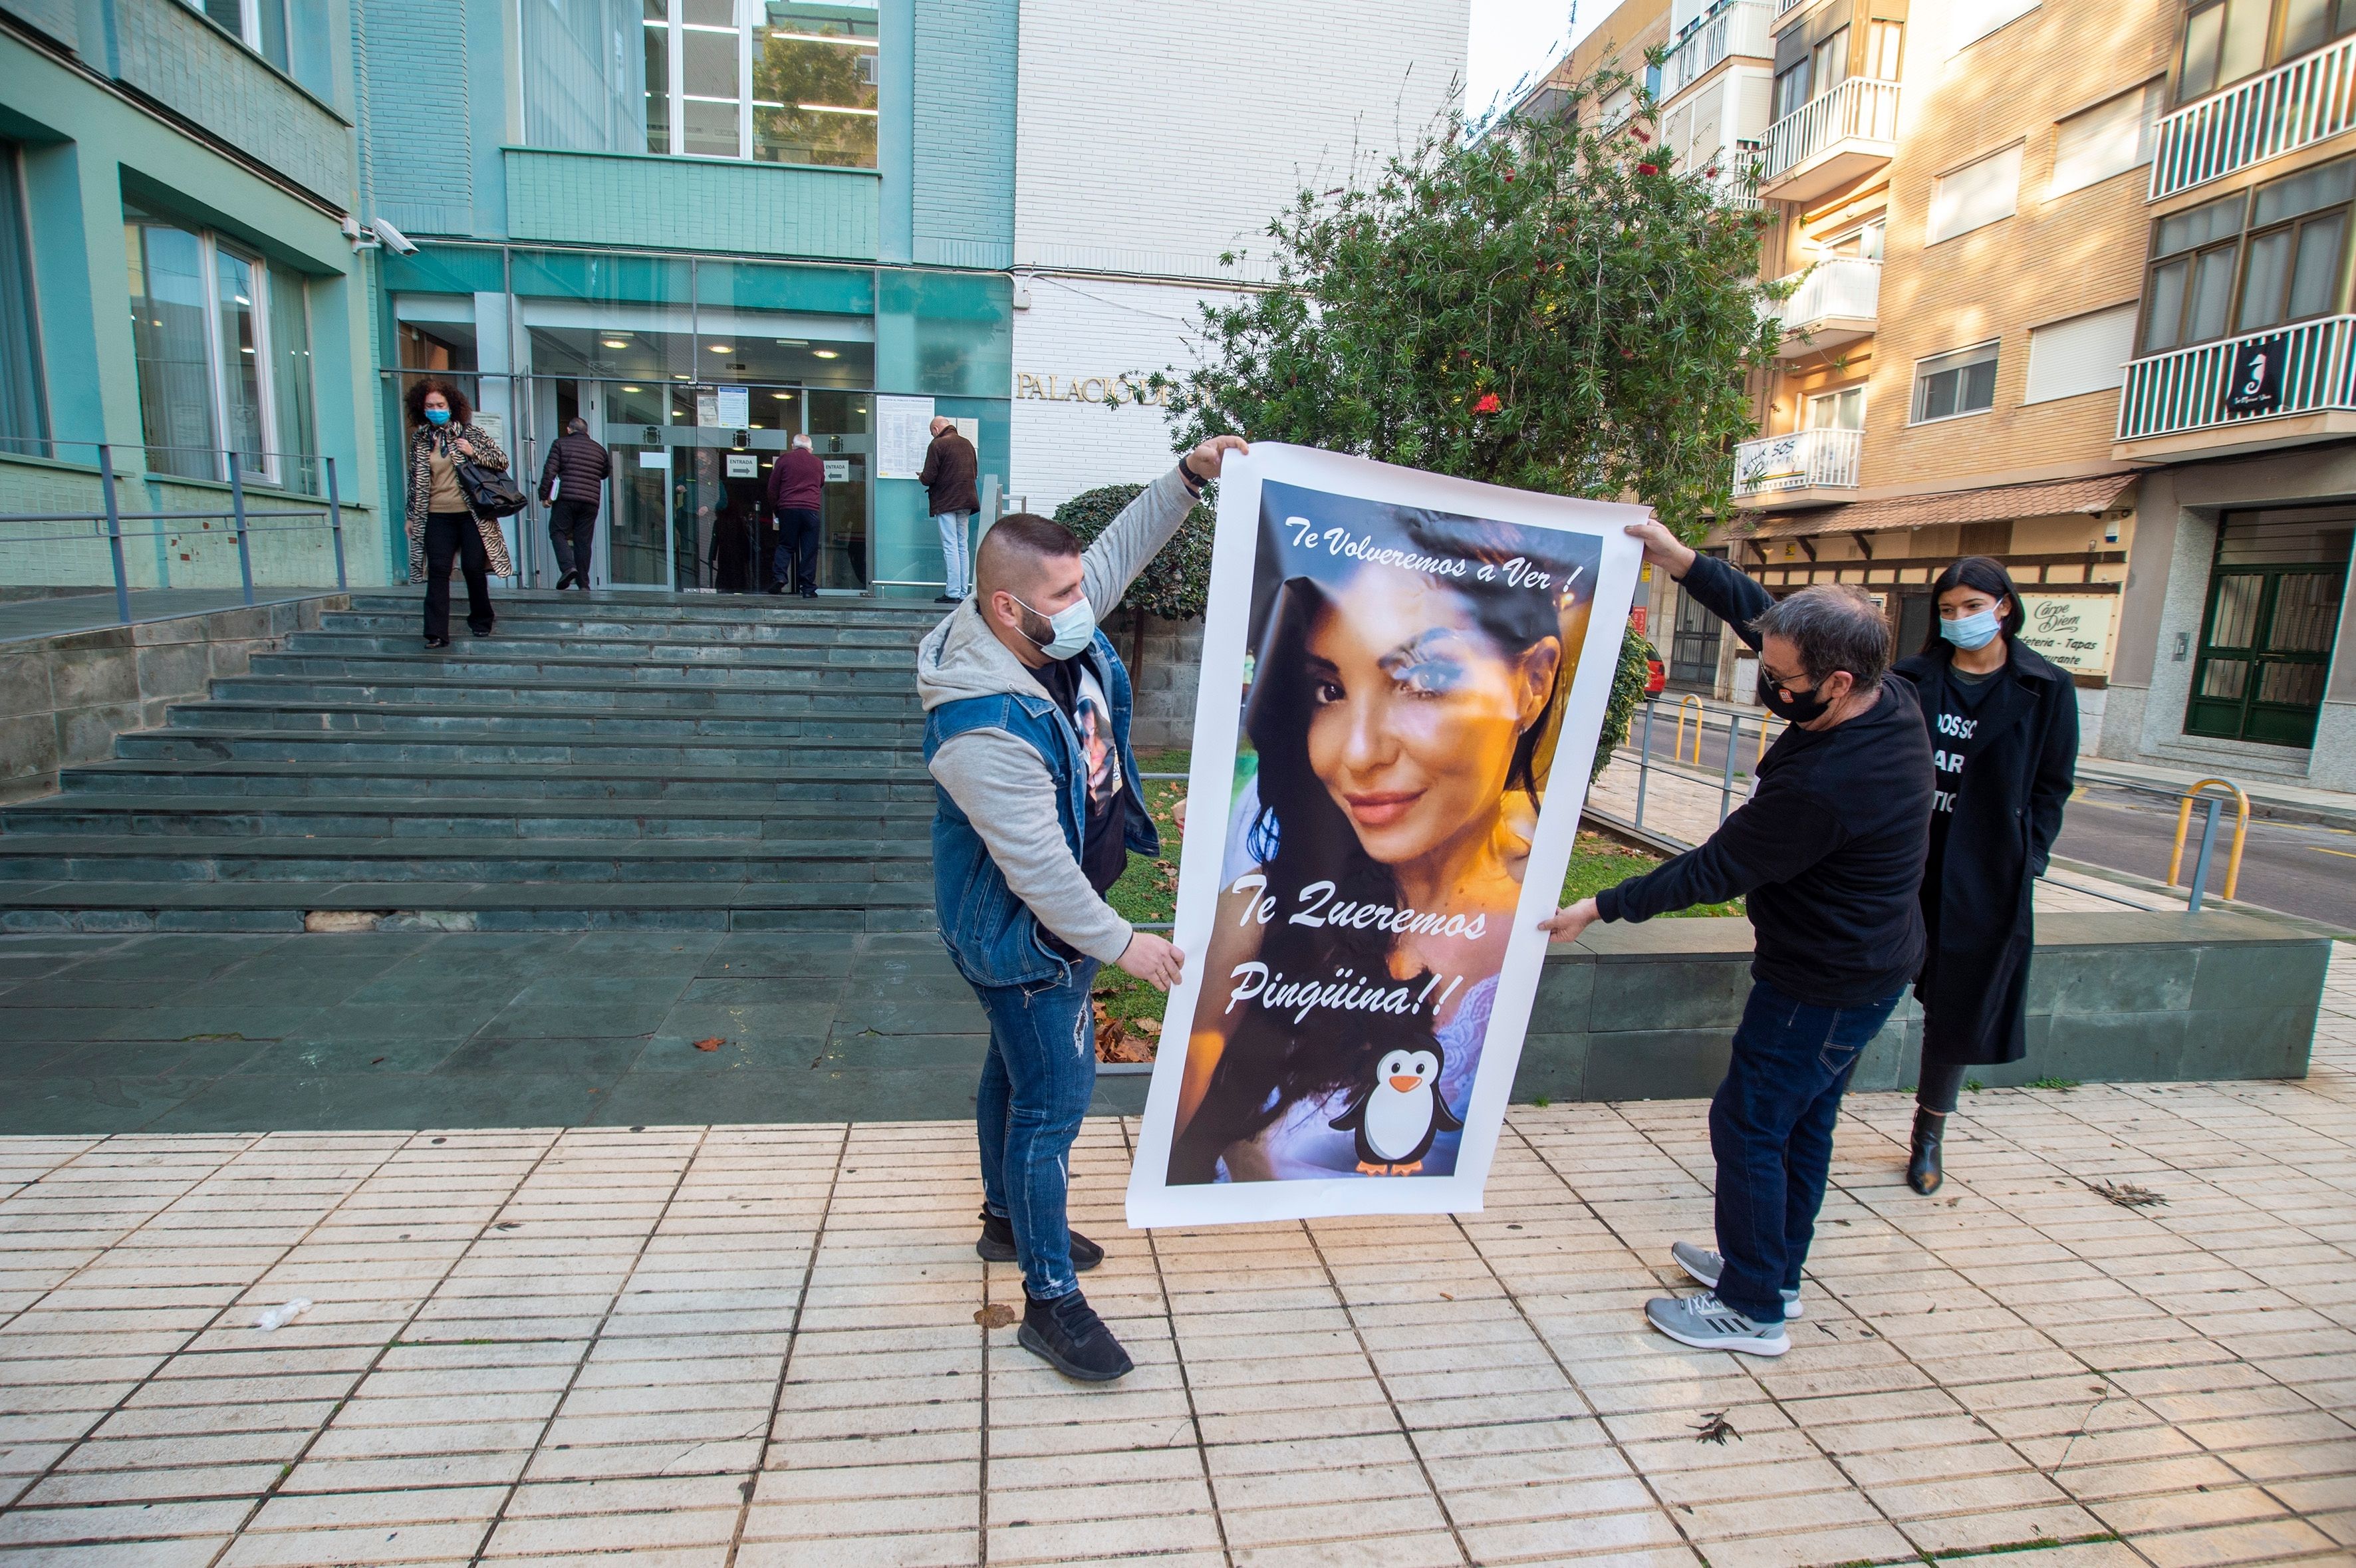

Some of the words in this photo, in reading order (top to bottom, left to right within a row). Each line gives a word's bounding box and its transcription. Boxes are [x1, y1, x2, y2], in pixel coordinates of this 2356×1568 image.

[1016, 373, 1132, 404] PALACIO
[1771, 440, 1795, 457] SOS
[1285, 516, 1319, 548] Te
[1323, 527, 1467, 577] Volveremos
[1477, 562, 1496, 582] a
[1503, 557, 1551, 590] Ver
[2034, 600, 2069, 619] Carpe
[2038, 614, 2081, 633] Diem
[2022, 636, 2055, 647] feteria
[2065, 638, 2098, 651] Tapas
[2043, 655, 2081, 665] aurante
[1232, 874, 1276, 927] Te
[1289, 880, 1486, 940] Queremos
[1225, 961, 1463, 1025] Pingüina!!
